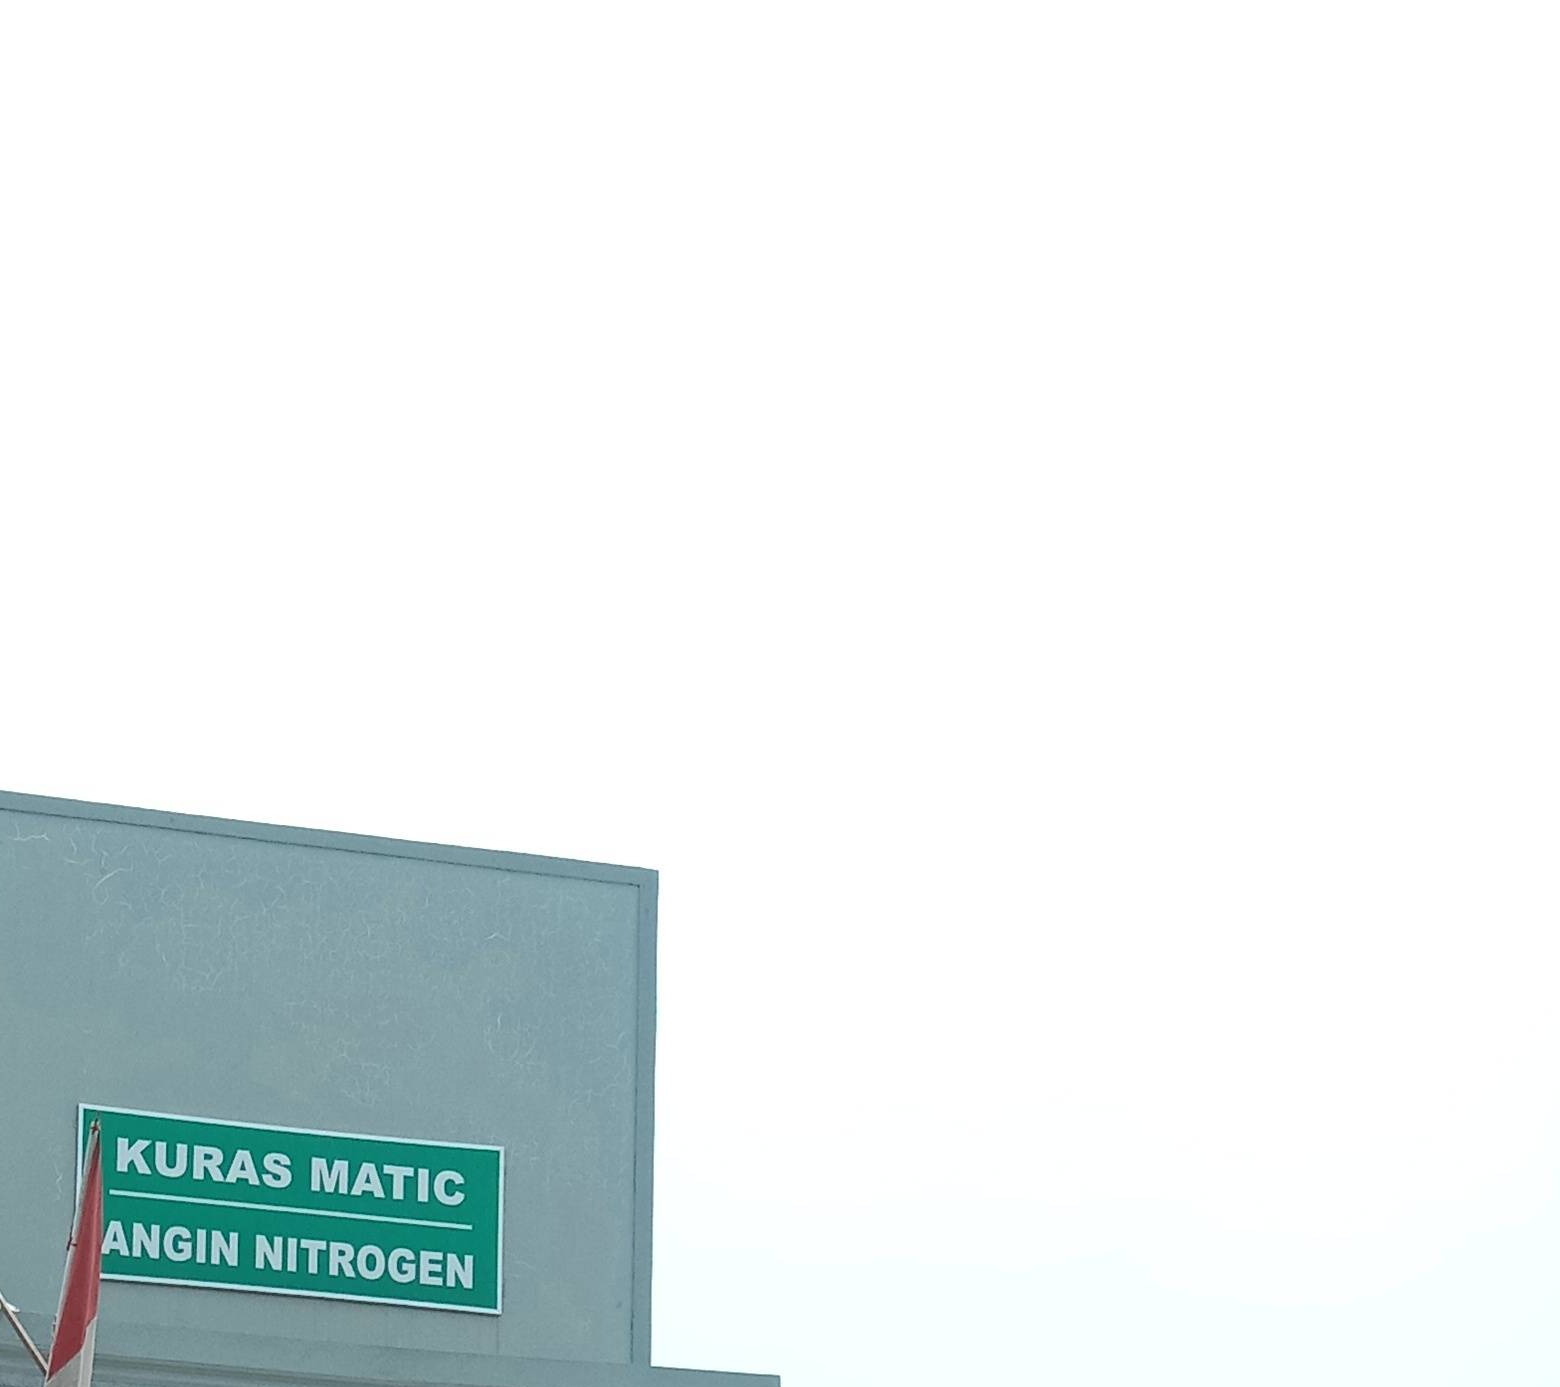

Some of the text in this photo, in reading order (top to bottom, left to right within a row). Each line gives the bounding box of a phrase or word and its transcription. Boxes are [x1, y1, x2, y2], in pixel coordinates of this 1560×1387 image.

[115, 1137, 466, 1207] KURAS MATIC
[101, 1220, 475, 1290] ANGIN NITROGEN
